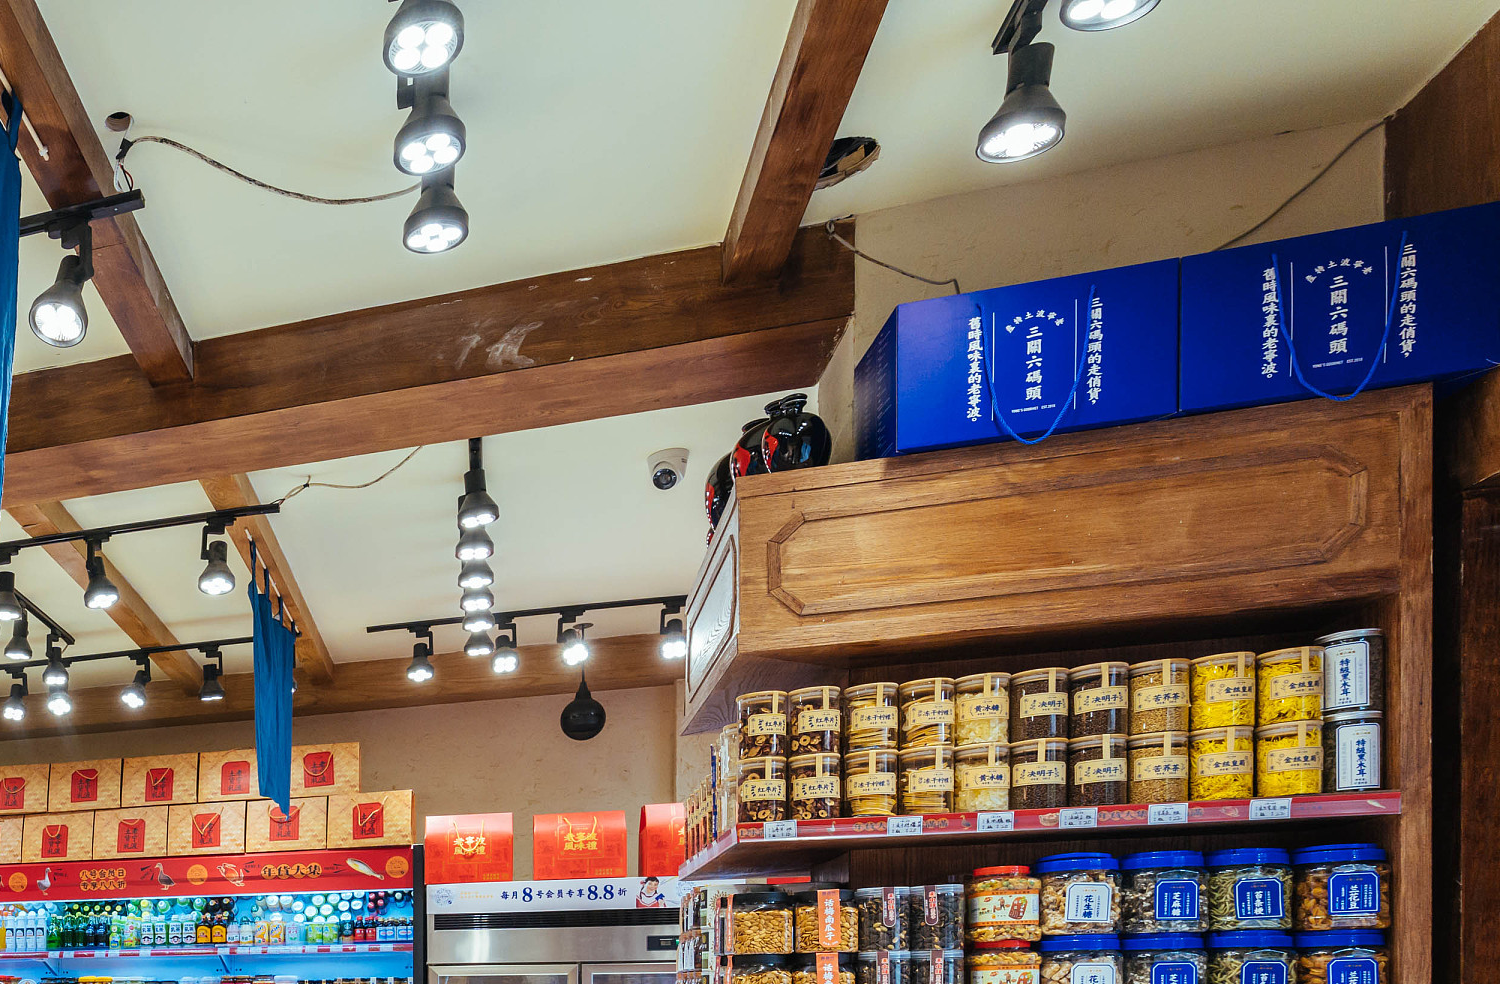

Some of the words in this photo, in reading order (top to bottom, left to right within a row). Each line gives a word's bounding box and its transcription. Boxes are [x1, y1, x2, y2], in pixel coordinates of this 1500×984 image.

[1328, 275, 1348, 354] 三關六碼頭
[1025, 326, 1043, 400] 三關六碼頭
[80, 868, 125, 879] 八号会员日
[262, 864, 321, 877] 年货大集
[80, 879, 125, 890] 专享八八折
[1083, 894, 1094, 919] 花生糖
[1171, 892, 1182, 916] 芝麻糖
[1347, 884, 1360, 910] 兰花豆
